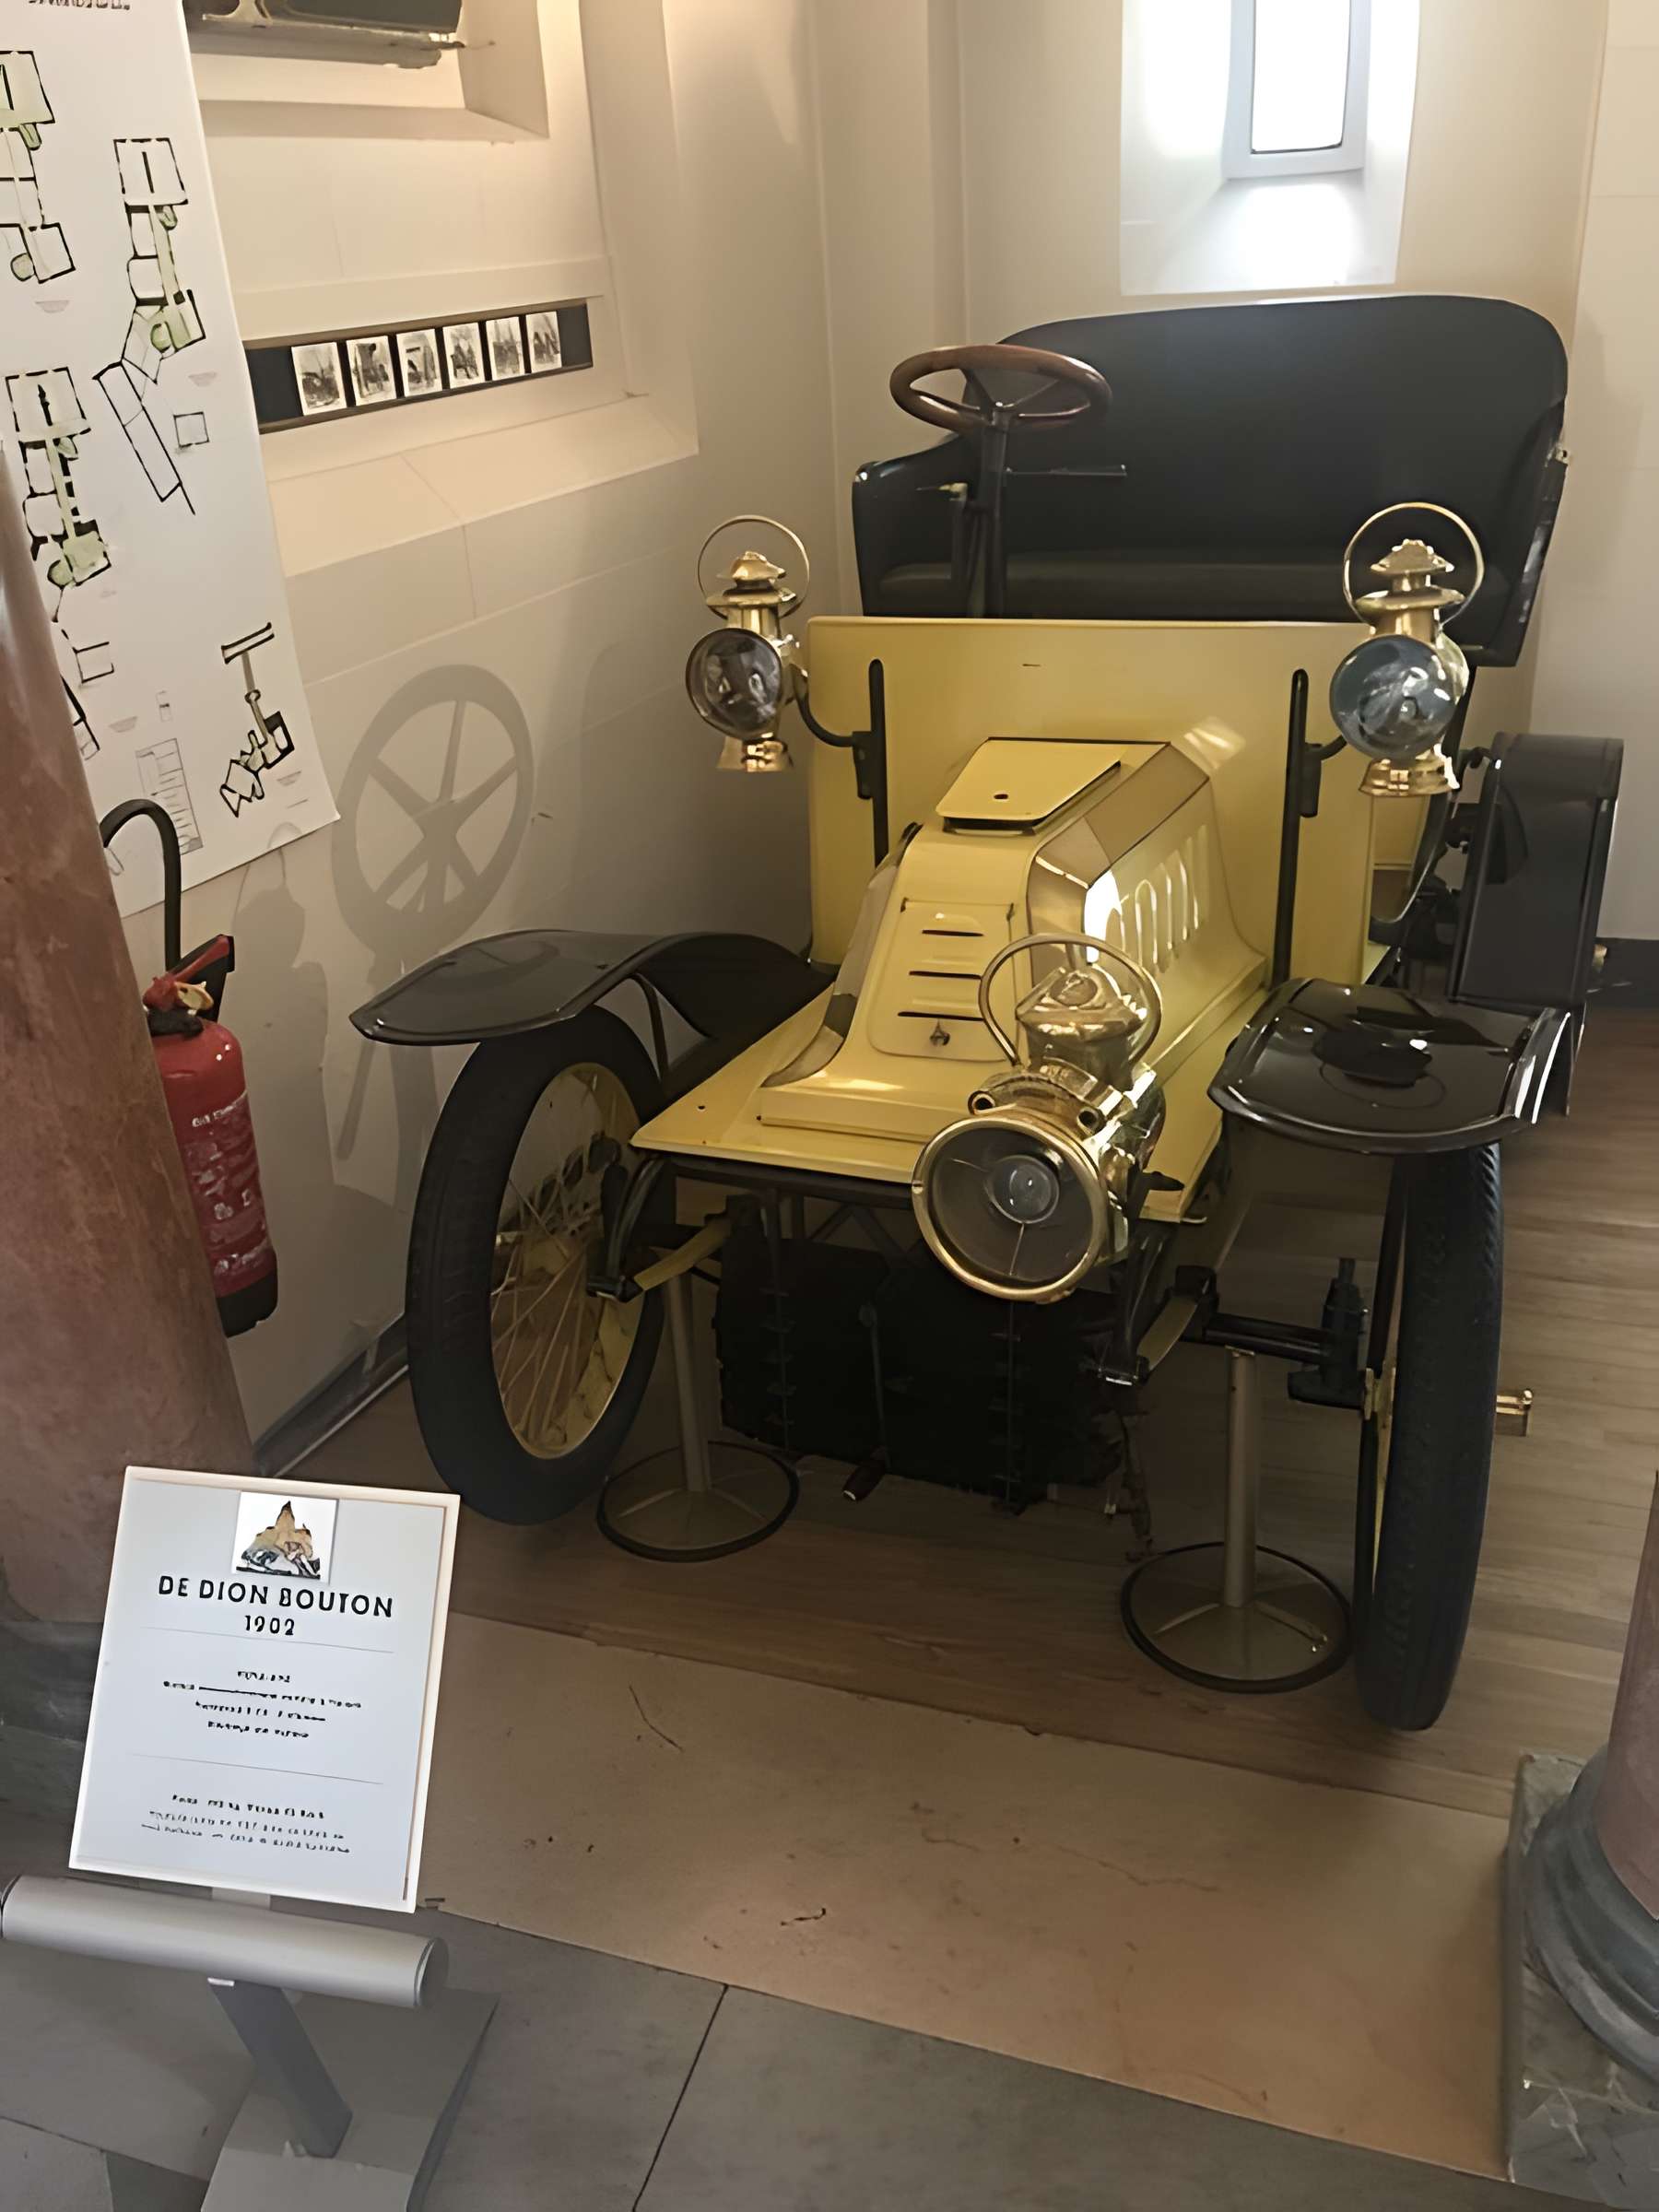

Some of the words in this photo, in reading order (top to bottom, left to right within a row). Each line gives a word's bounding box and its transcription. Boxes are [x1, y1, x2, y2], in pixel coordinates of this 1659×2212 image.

[158, 1575, 190, 1597] DE
[198, 1579, 269, 1605] DION
[278, 1587, 394, 1618] BOUTON
[244, 1615, 296, 1636] 1902
